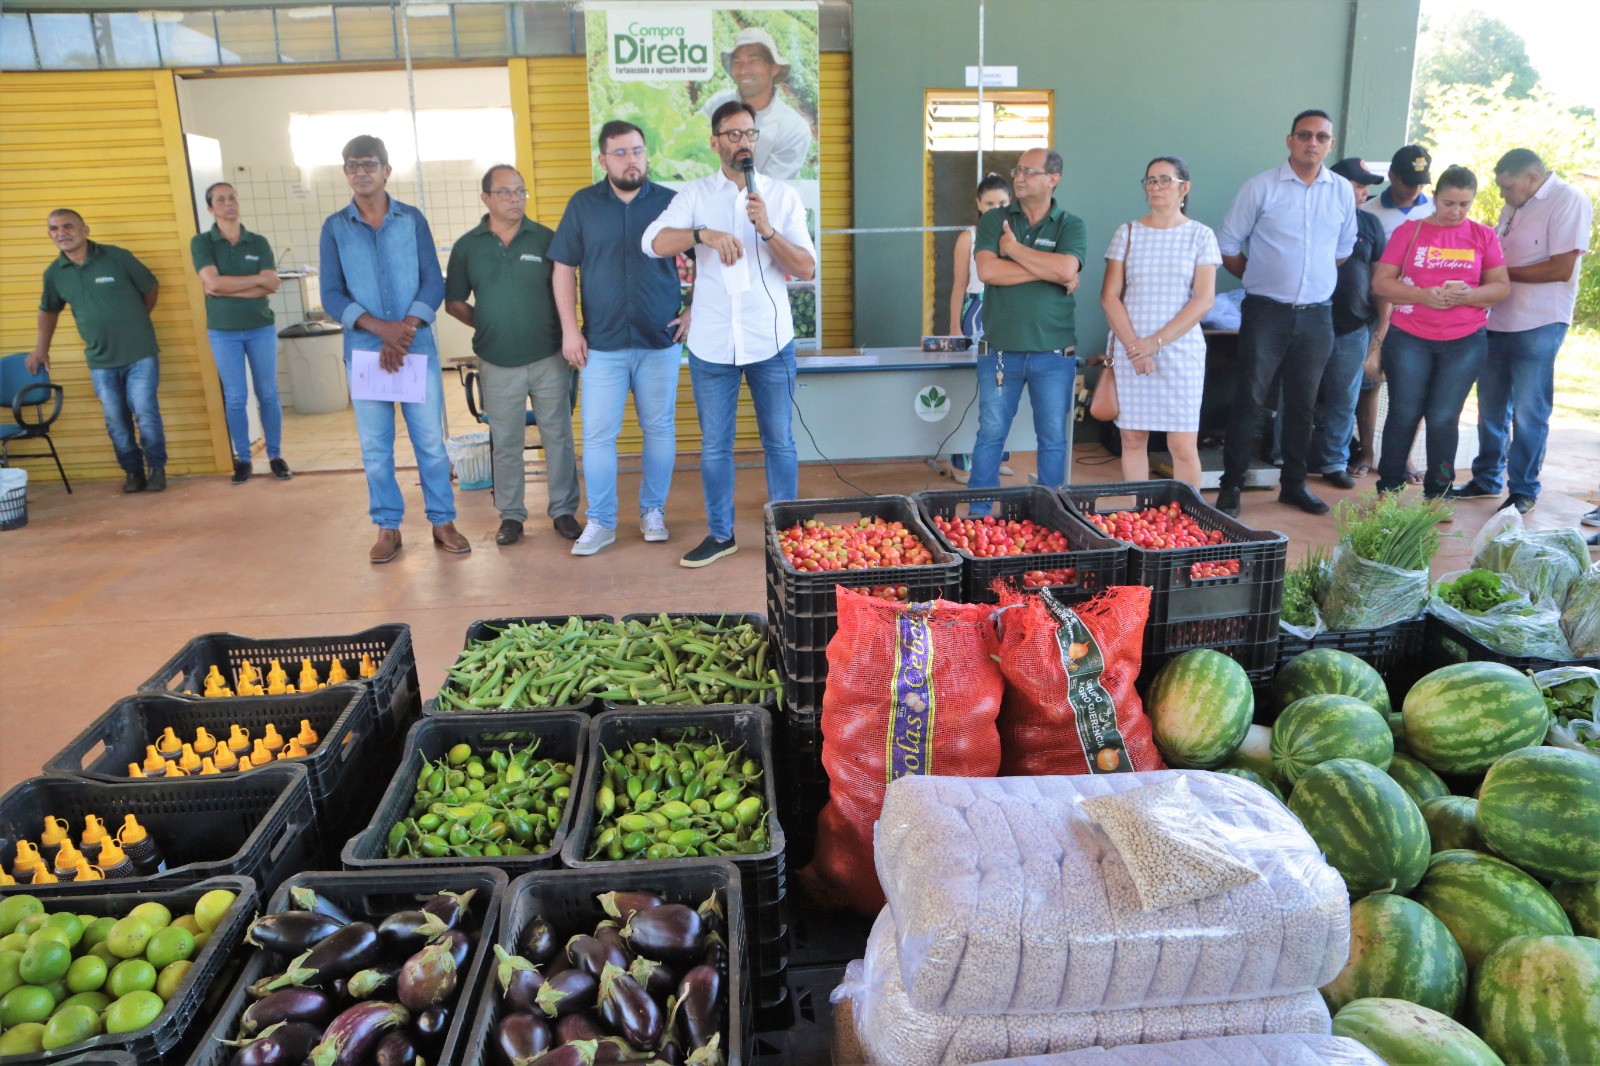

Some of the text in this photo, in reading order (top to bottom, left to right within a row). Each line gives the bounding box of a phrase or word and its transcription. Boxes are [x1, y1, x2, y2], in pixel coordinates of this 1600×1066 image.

[628, 22, 685, 40] Compra
[614, 34, 708, 64] Direta
[904, 614, 926, 688] Cebol
[1078, 682, 1091, 703] AGRO
[1085, 678, 1103, 703] GRUPO
[895, 715, 922, 781] olas
